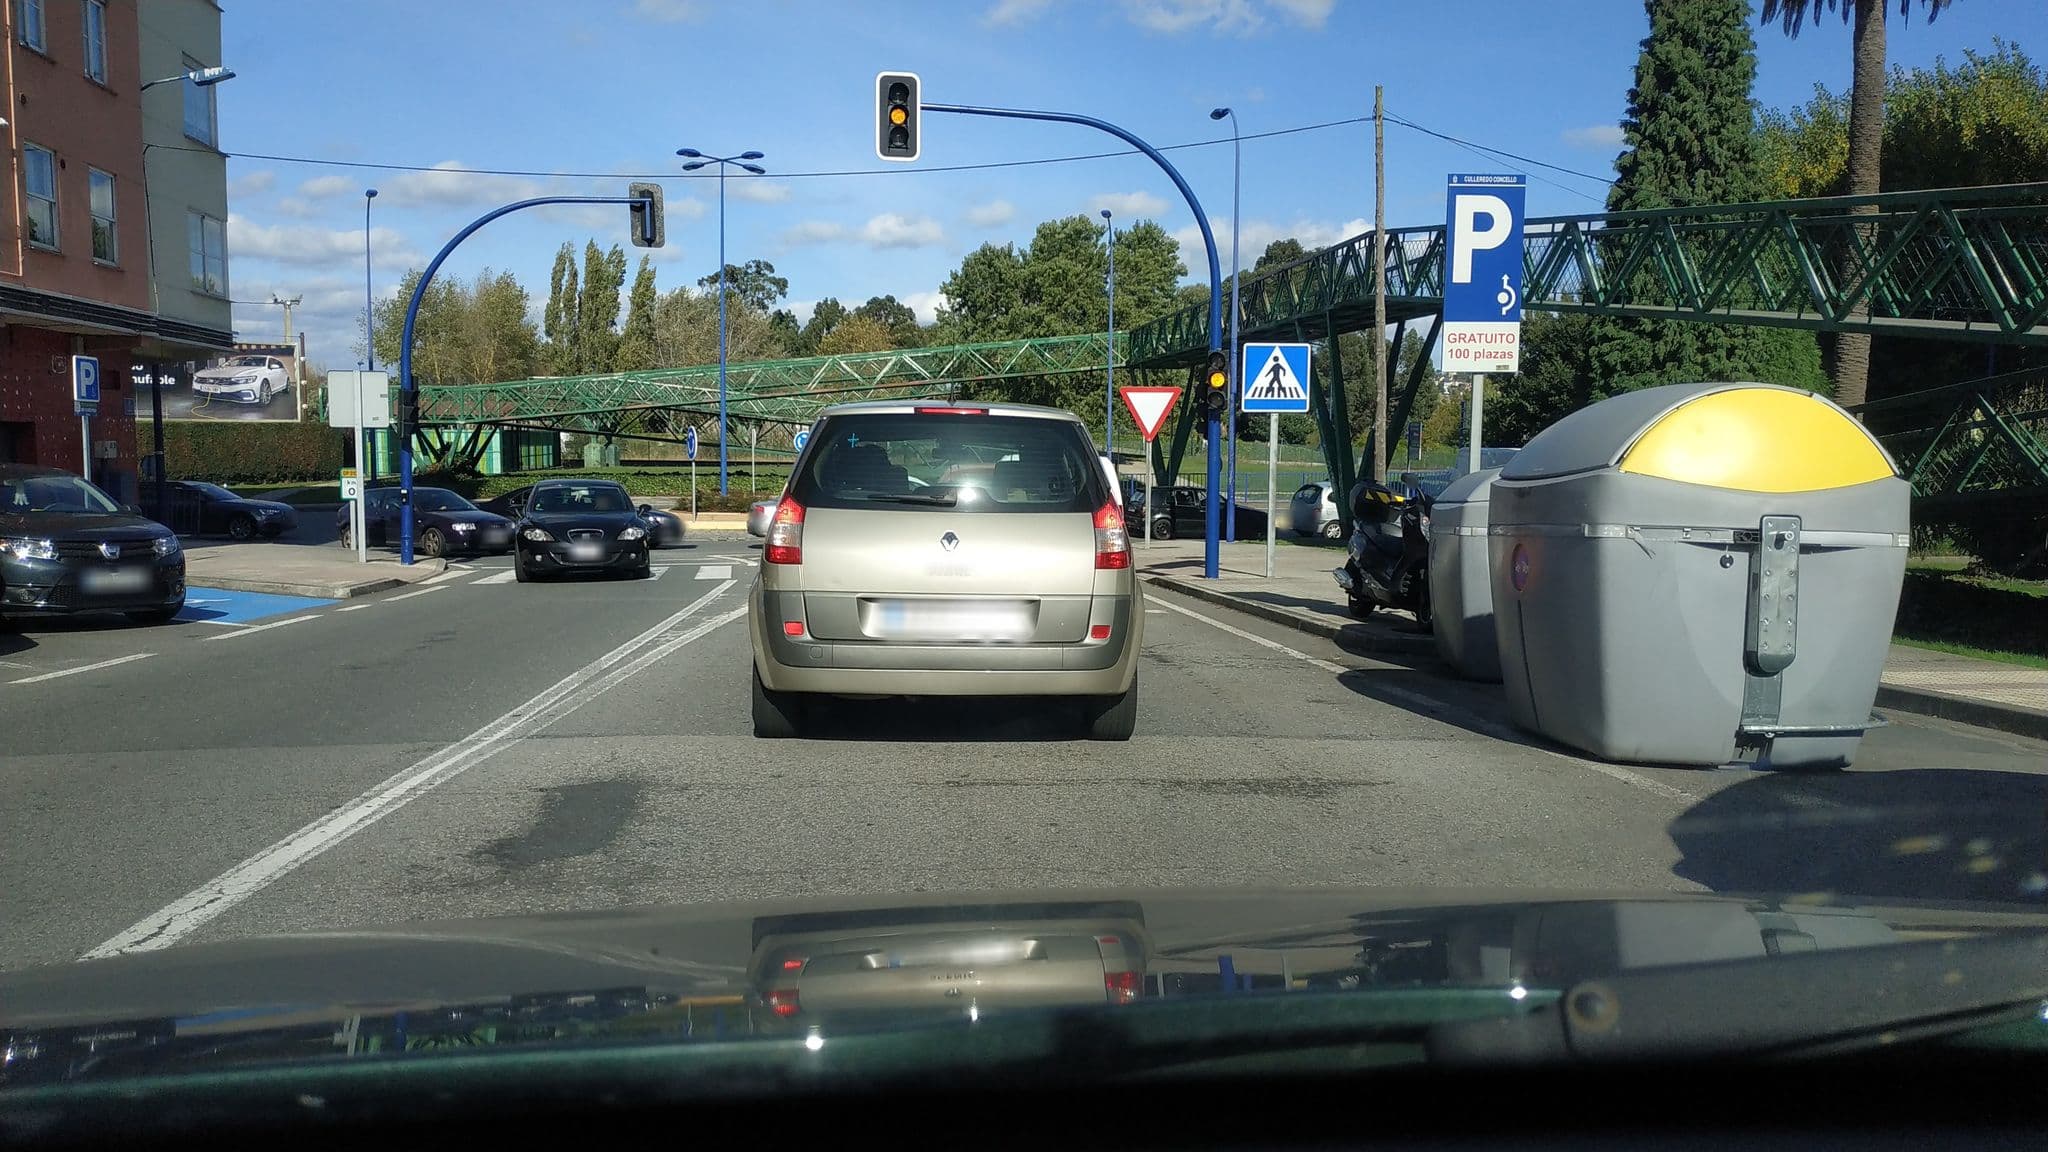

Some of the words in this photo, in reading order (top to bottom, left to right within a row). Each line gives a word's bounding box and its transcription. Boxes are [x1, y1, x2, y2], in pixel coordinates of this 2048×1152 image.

[1463, 175, 1493, 183] CULLEREDO
[1452, 194, 1513, 283] P
[1447, 332, 1516, 344] GRATUITO
[1448, 348, 1470, 359] 100
[1473, 348, 1514, 361] plazas
[80, 361, 95, 398] P
